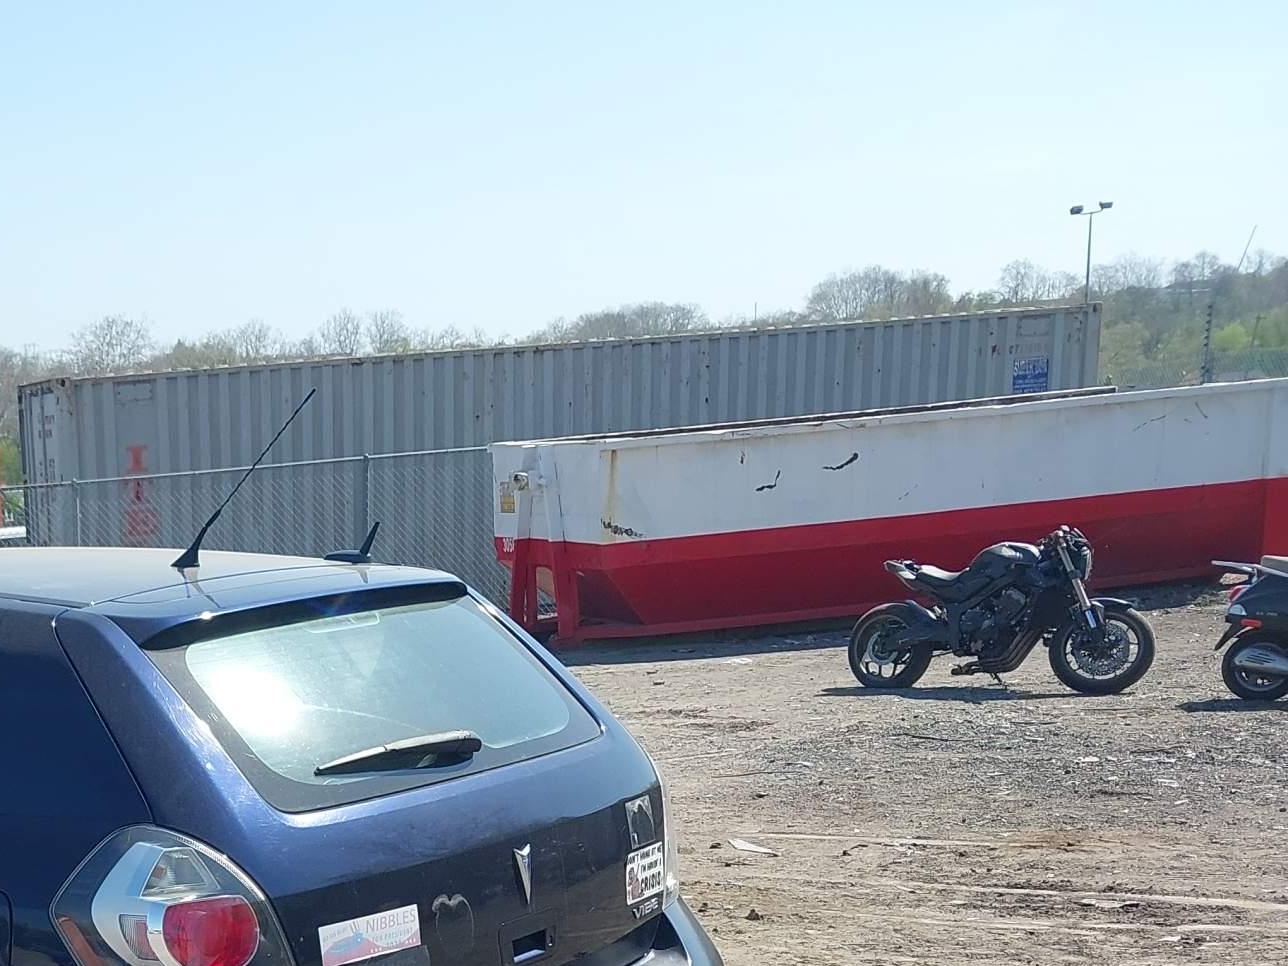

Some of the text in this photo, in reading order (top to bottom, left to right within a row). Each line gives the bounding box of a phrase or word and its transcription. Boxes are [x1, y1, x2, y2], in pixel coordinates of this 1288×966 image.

[641, 871, 661, 894] CRISIS
[632, 897, 659, 919] VIBE
[366, 908, 416, 933] NIBBLES
